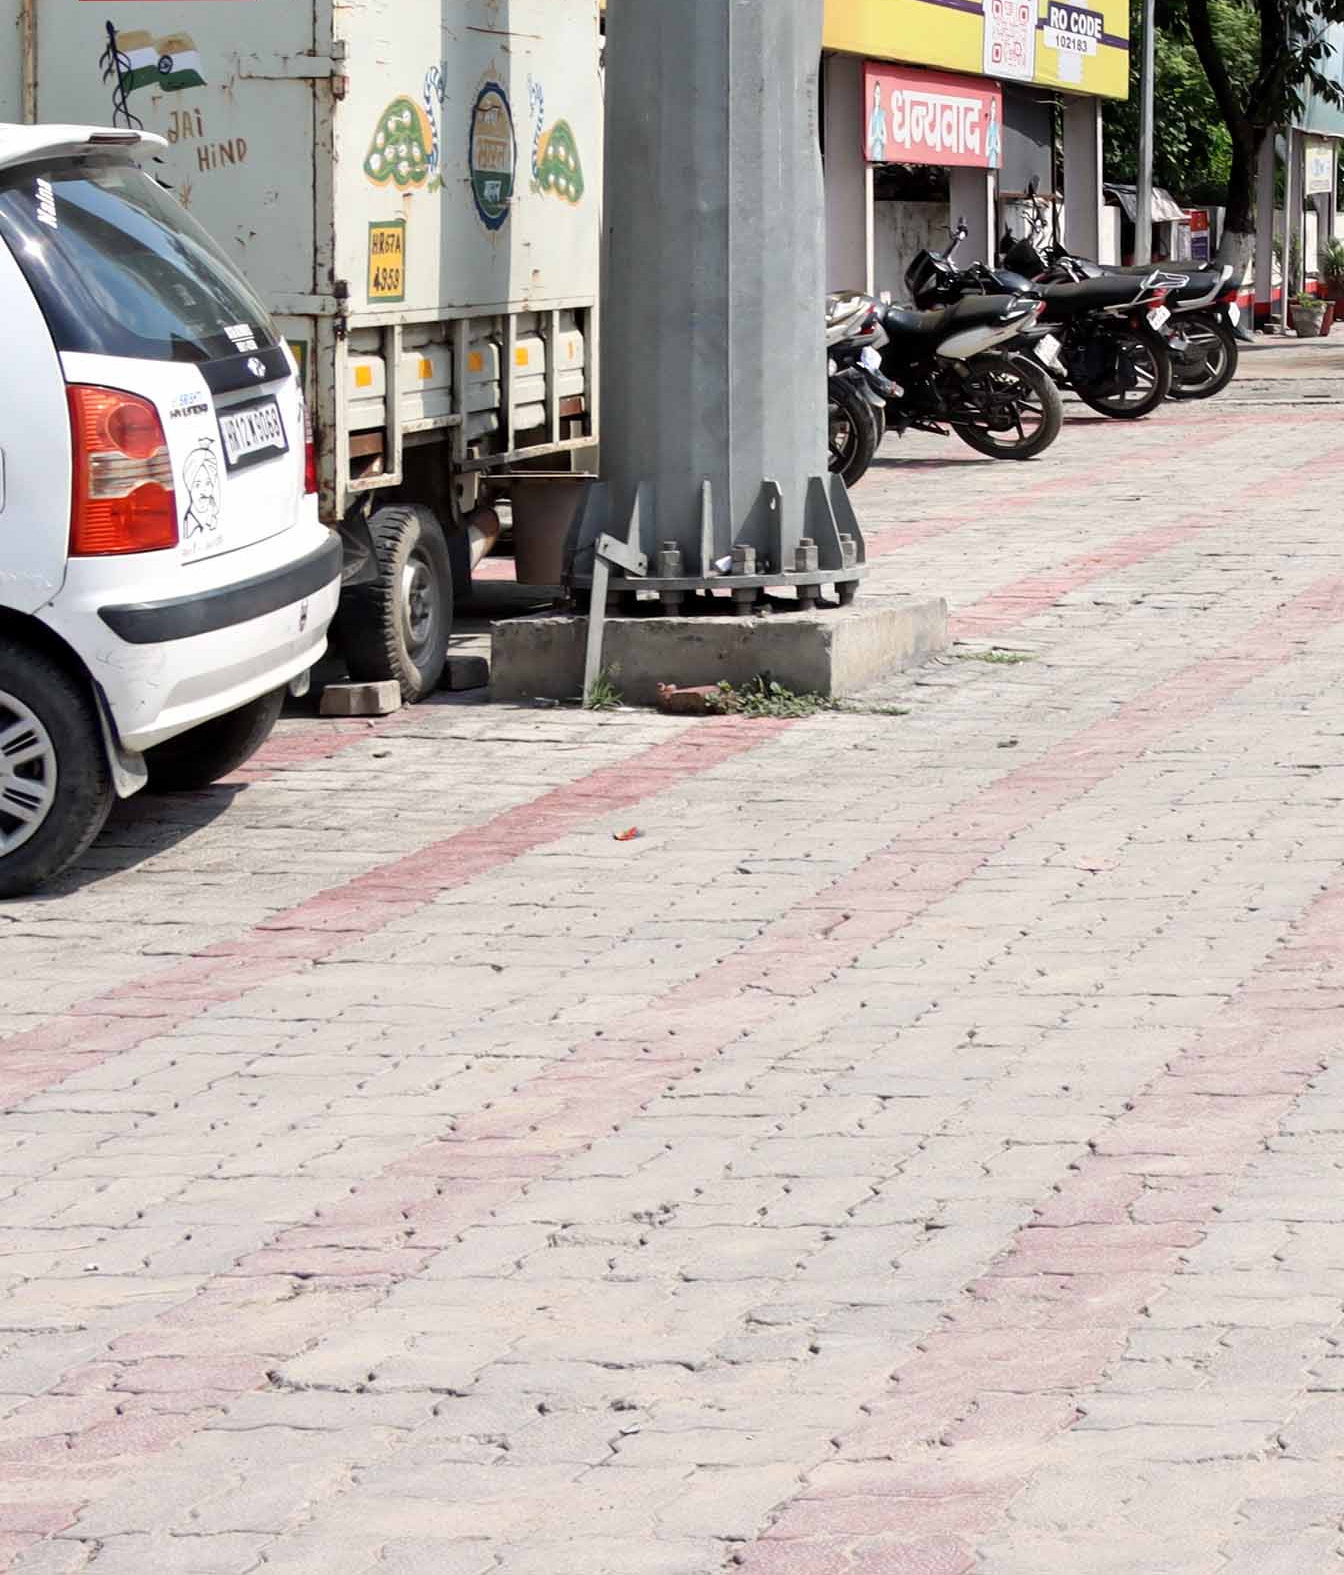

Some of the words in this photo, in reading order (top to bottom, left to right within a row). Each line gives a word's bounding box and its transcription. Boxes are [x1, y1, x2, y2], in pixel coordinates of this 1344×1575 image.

[1050, 7, 1069, 29] RO
[1070, 12, 1103, 39] CODE
[1056, 34, 1088, 52] 102183
[891, 90, 983, 155] धन्यवाद
